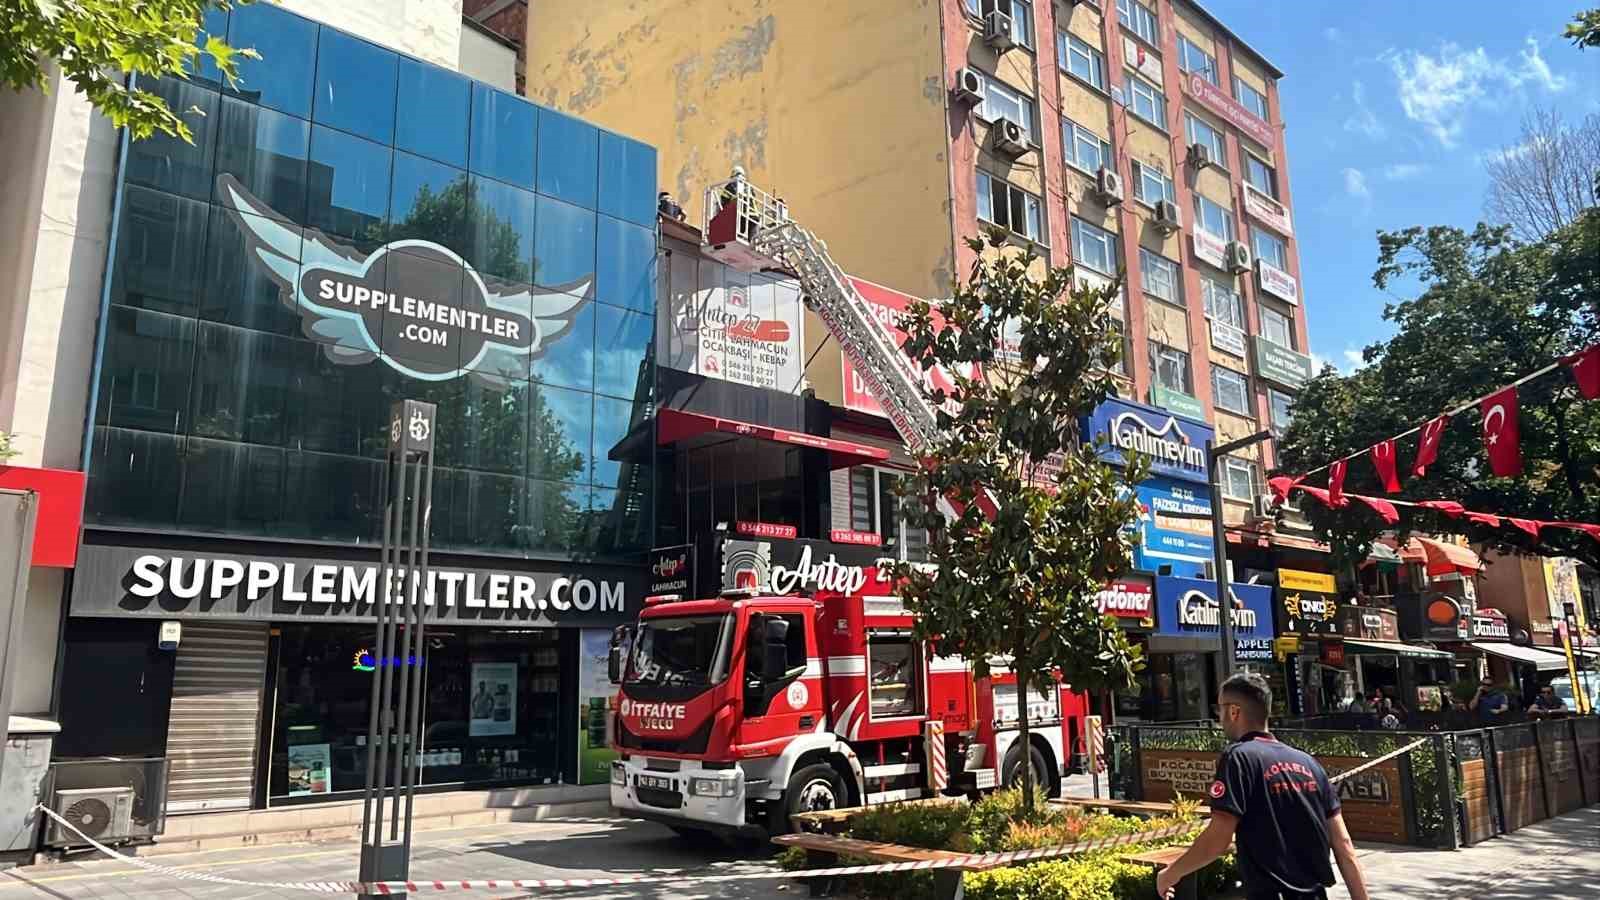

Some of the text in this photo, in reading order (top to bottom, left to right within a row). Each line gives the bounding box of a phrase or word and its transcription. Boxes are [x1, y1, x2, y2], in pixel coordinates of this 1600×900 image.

[318, 278, 521, 341] SUPPLEMENTLER
[398, 322, 448, 347] .COM
[759, 353, 786, 367] KEBAP
[129, 554, 625, 612] SUPPLEMENTLER.COM
[771, 545, 867, 596] Antep
[1237, 640, 1270, 649] APPLE
[631, 700, 686, 719] İTFAİYE
